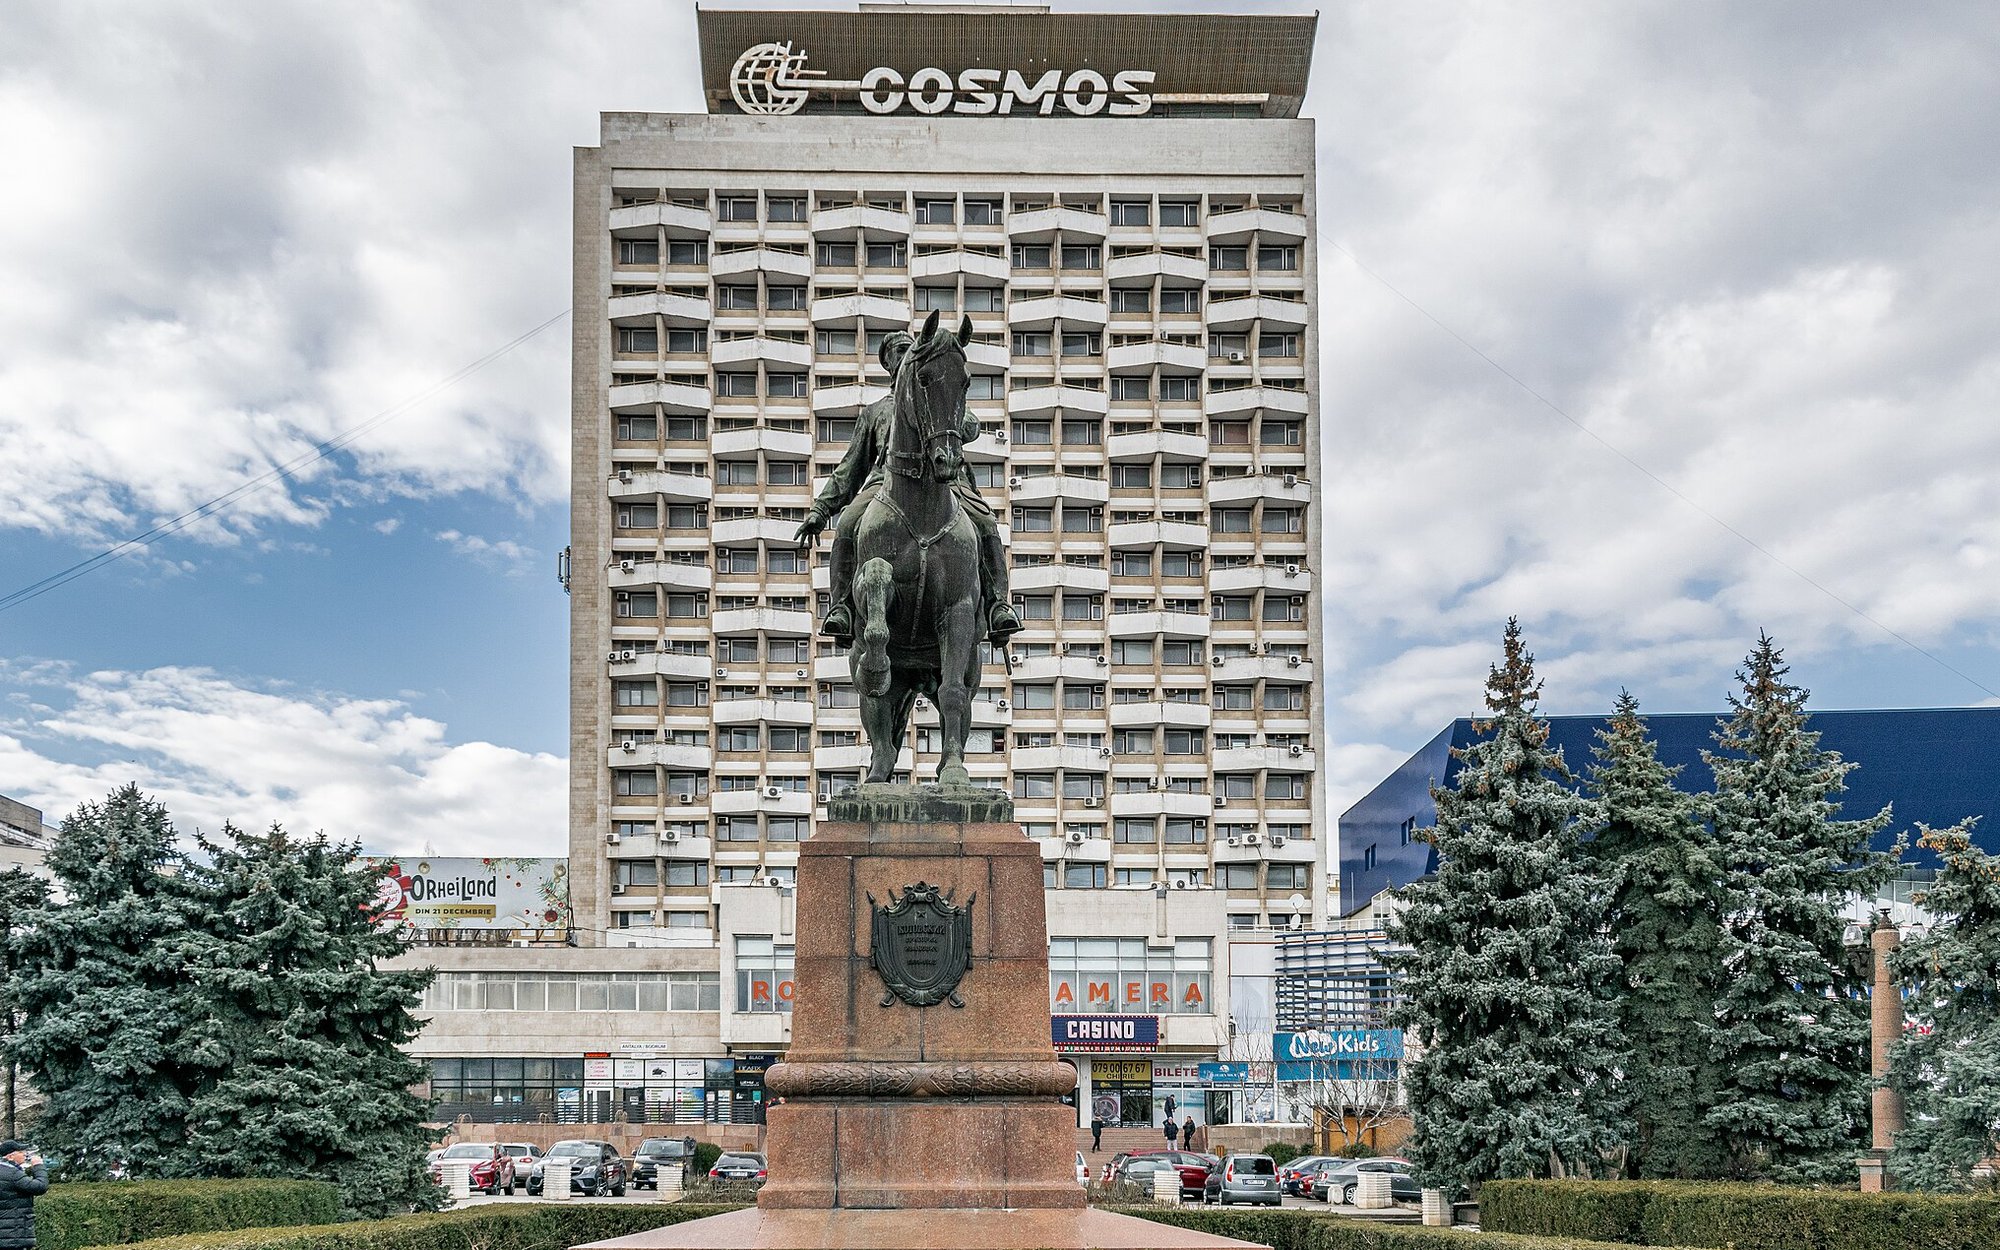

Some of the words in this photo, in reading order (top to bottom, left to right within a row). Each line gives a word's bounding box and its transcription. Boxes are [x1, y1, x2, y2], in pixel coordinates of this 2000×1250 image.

[859, 66, 1156, 116] COSMOS
[1066, 1020, 1135, 1039] CASINO
[1092, 1063, 1108, 1073] 079
[1110, 1063, 1120, 1073] 00
[1122, 1063, 1133, 1073] 67
[1135, 1063, 1145, 1073] 67
[1154, 1067, 1199, 1077] BILETE
